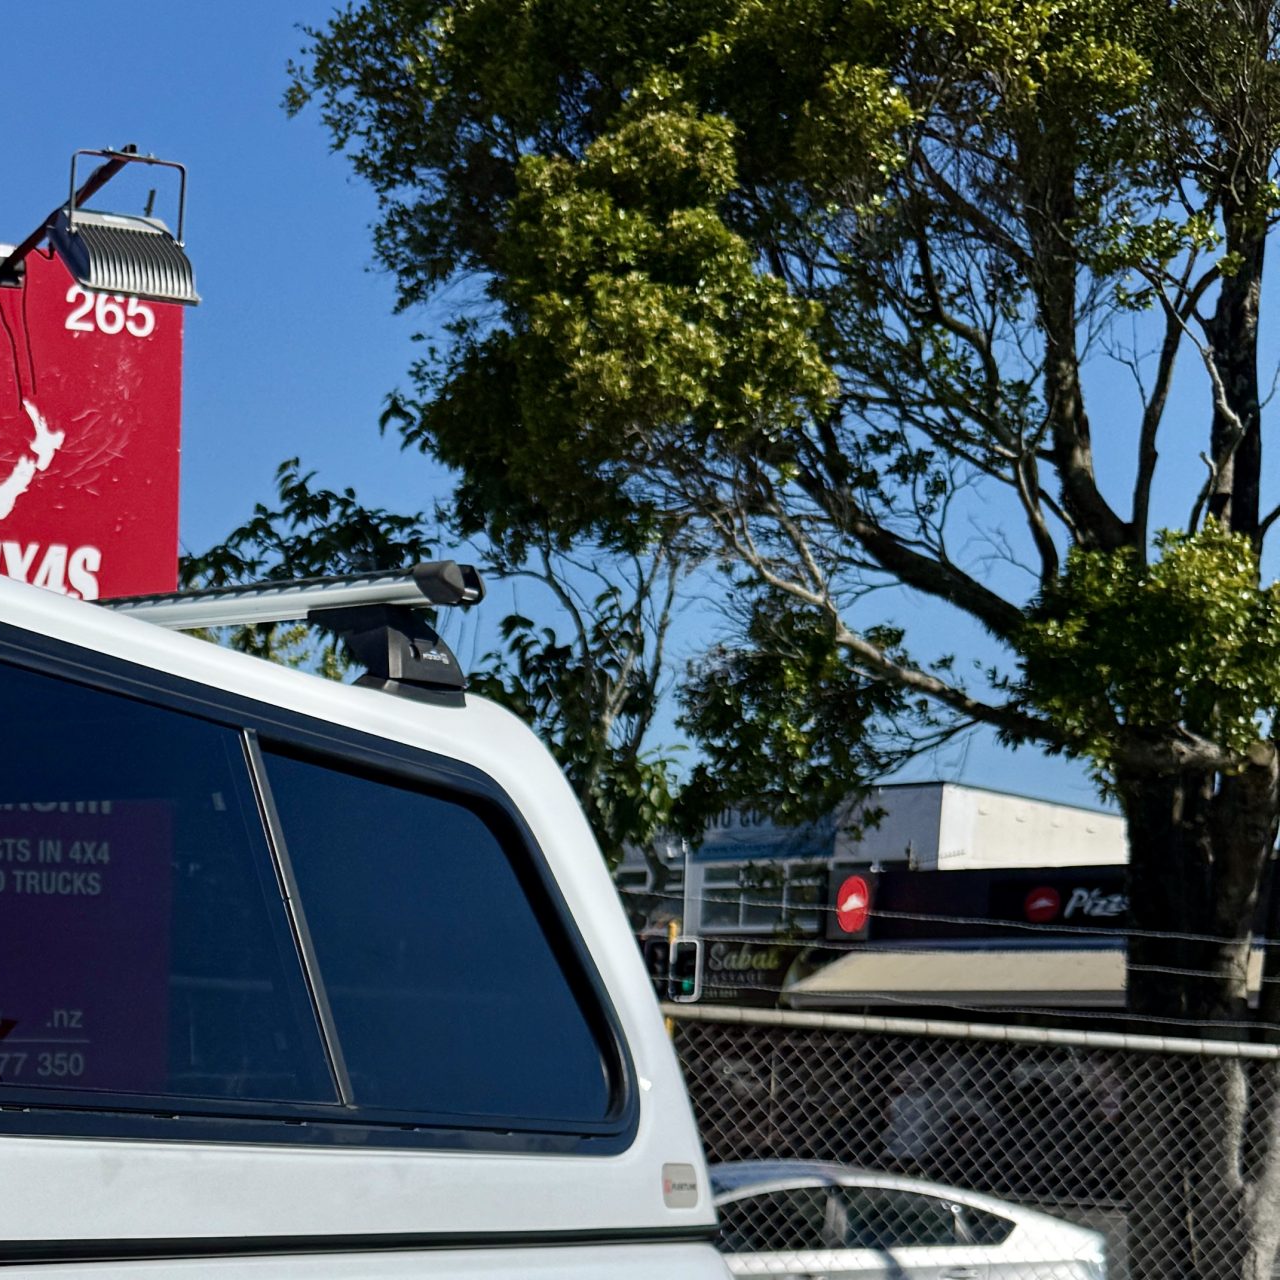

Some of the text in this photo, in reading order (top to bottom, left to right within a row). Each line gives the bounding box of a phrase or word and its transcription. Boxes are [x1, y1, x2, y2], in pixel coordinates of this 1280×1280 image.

[65, 284, 155, 338] 265
[38, 839, 62, 864] IN
[69, 841, 111, 865] 4X4
[12, 870, 102, 895] TRUCKS
[36, 1052, 85, 1077] 350
